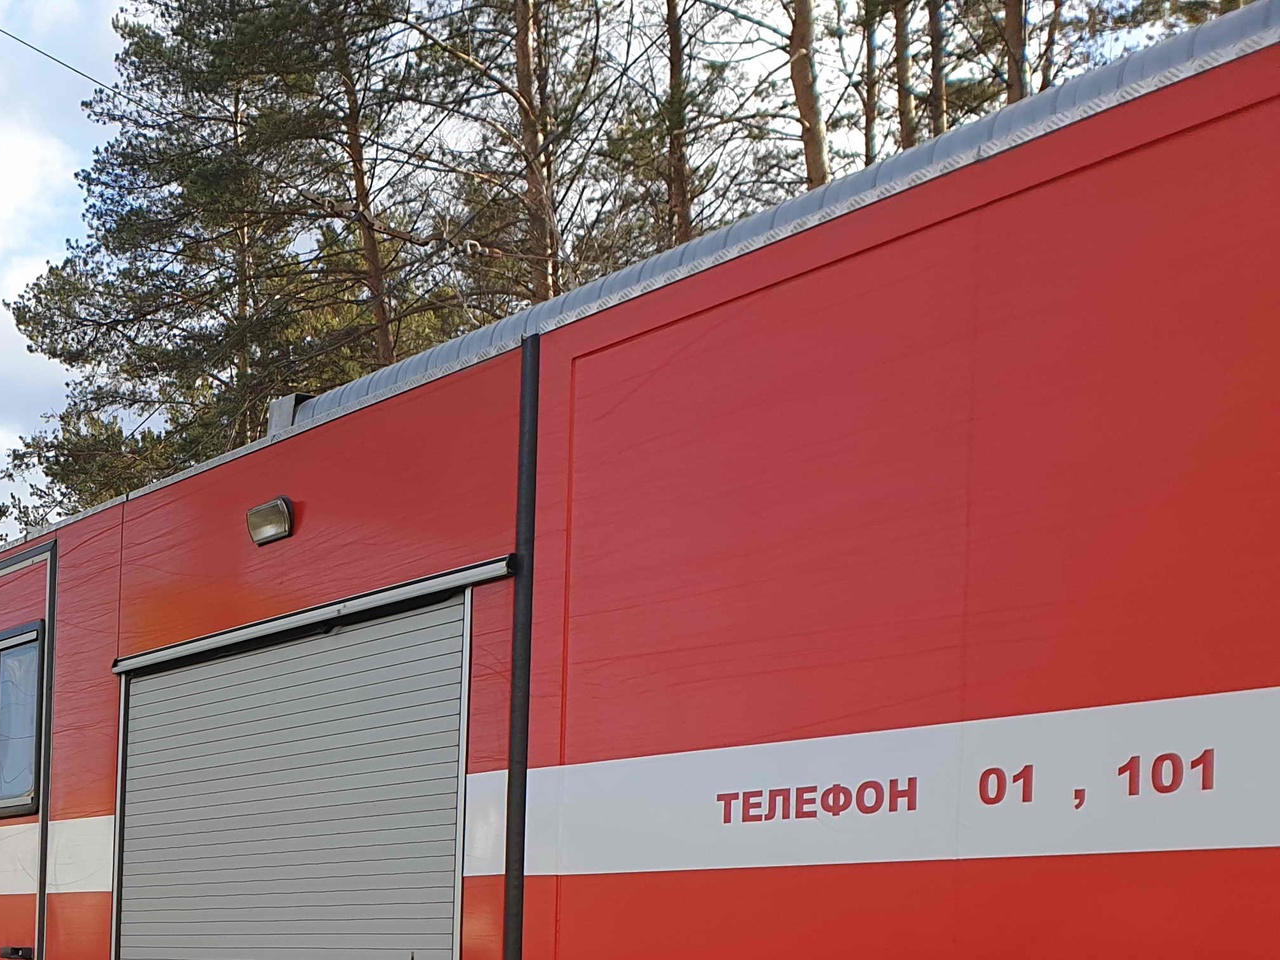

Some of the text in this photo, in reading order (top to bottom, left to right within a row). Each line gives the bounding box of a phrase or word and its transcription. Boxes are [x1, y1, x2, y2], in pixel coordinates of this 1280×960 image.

[716, 777, 918, 824] ТЕЛЕФОН
[978, 764, 1034, 805] 01
[1118, 748, 1216, 797] 101
